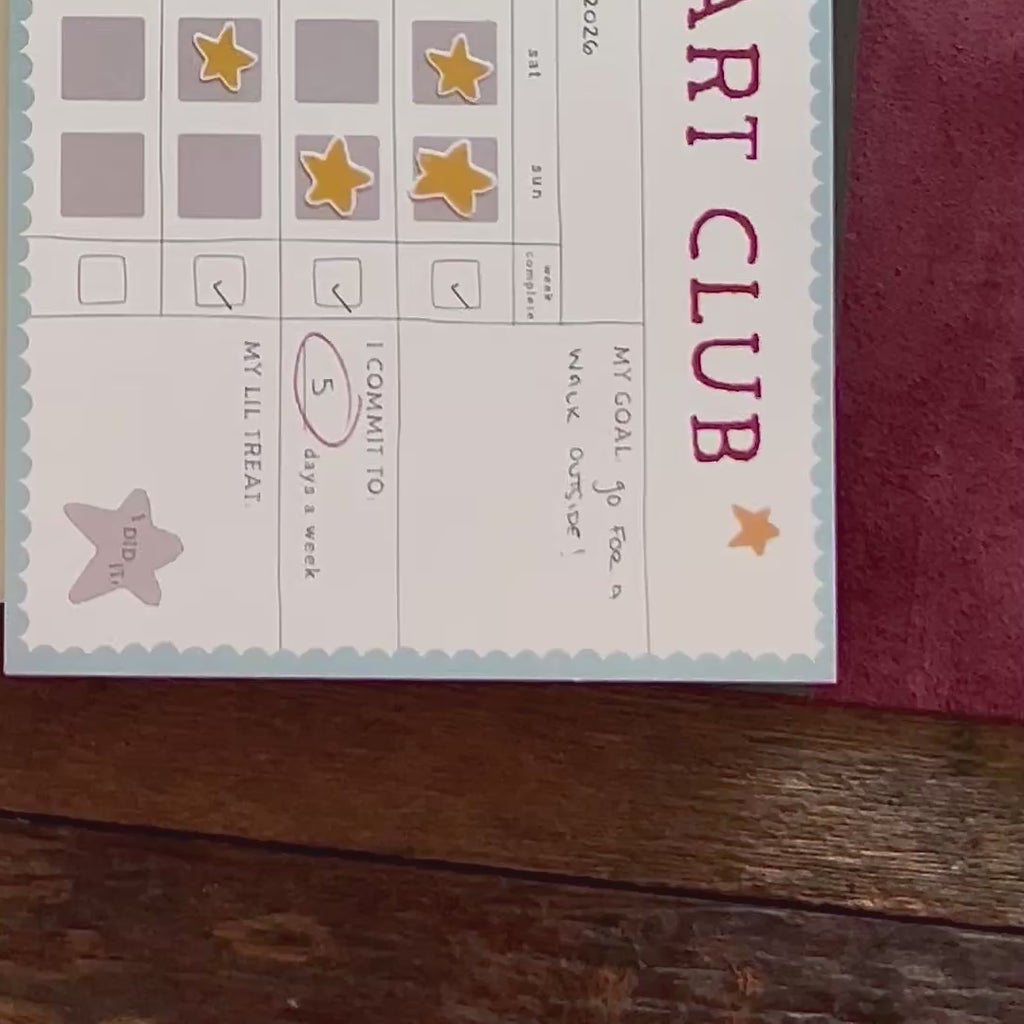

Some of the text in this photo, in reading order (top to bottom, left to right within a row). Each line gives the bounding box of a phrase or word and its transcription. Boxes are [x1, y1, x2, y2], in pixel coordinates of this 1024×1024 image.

[527, 48, 542, 78] sat
[531, 164, 544, 200] sun
[689, 207, 763, 463] CLUB
[243, 340, 263, 377] MY
[612, 345, 632, 382] MY
[243, 385, 262, 420] LIL
[311, 377, 334, 396] 5
[366, 357, 384, 456] COMMIT
[131, 513, 146, 522] I
[299, 447, 321, 579] days a week
[122, 527, 137, 561] DID
